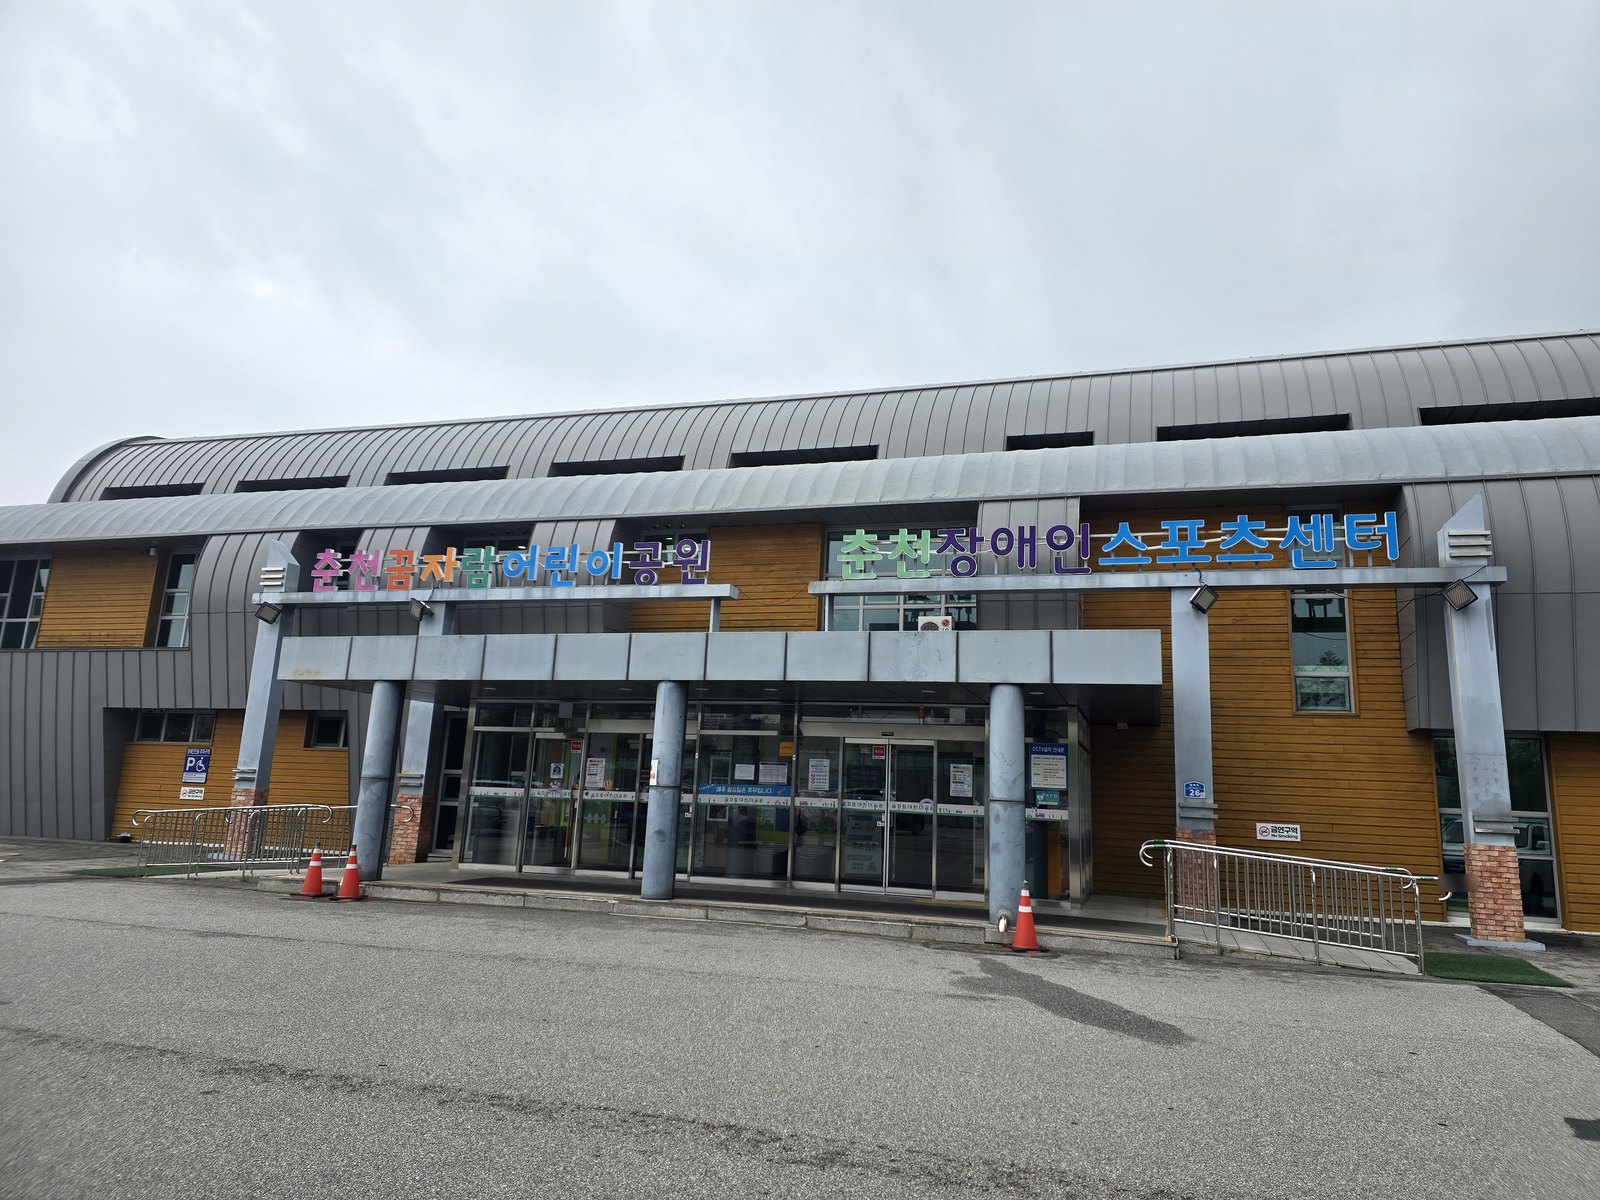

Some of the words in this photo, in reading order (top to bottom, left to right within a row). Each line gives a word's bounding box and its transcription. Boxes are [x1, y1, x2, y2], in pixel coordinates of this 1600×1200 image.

[186, 757, 196, 771] P
[1189, 789, 1200, 797] 26
[1270, 825, 1298, 834] 금연구역
